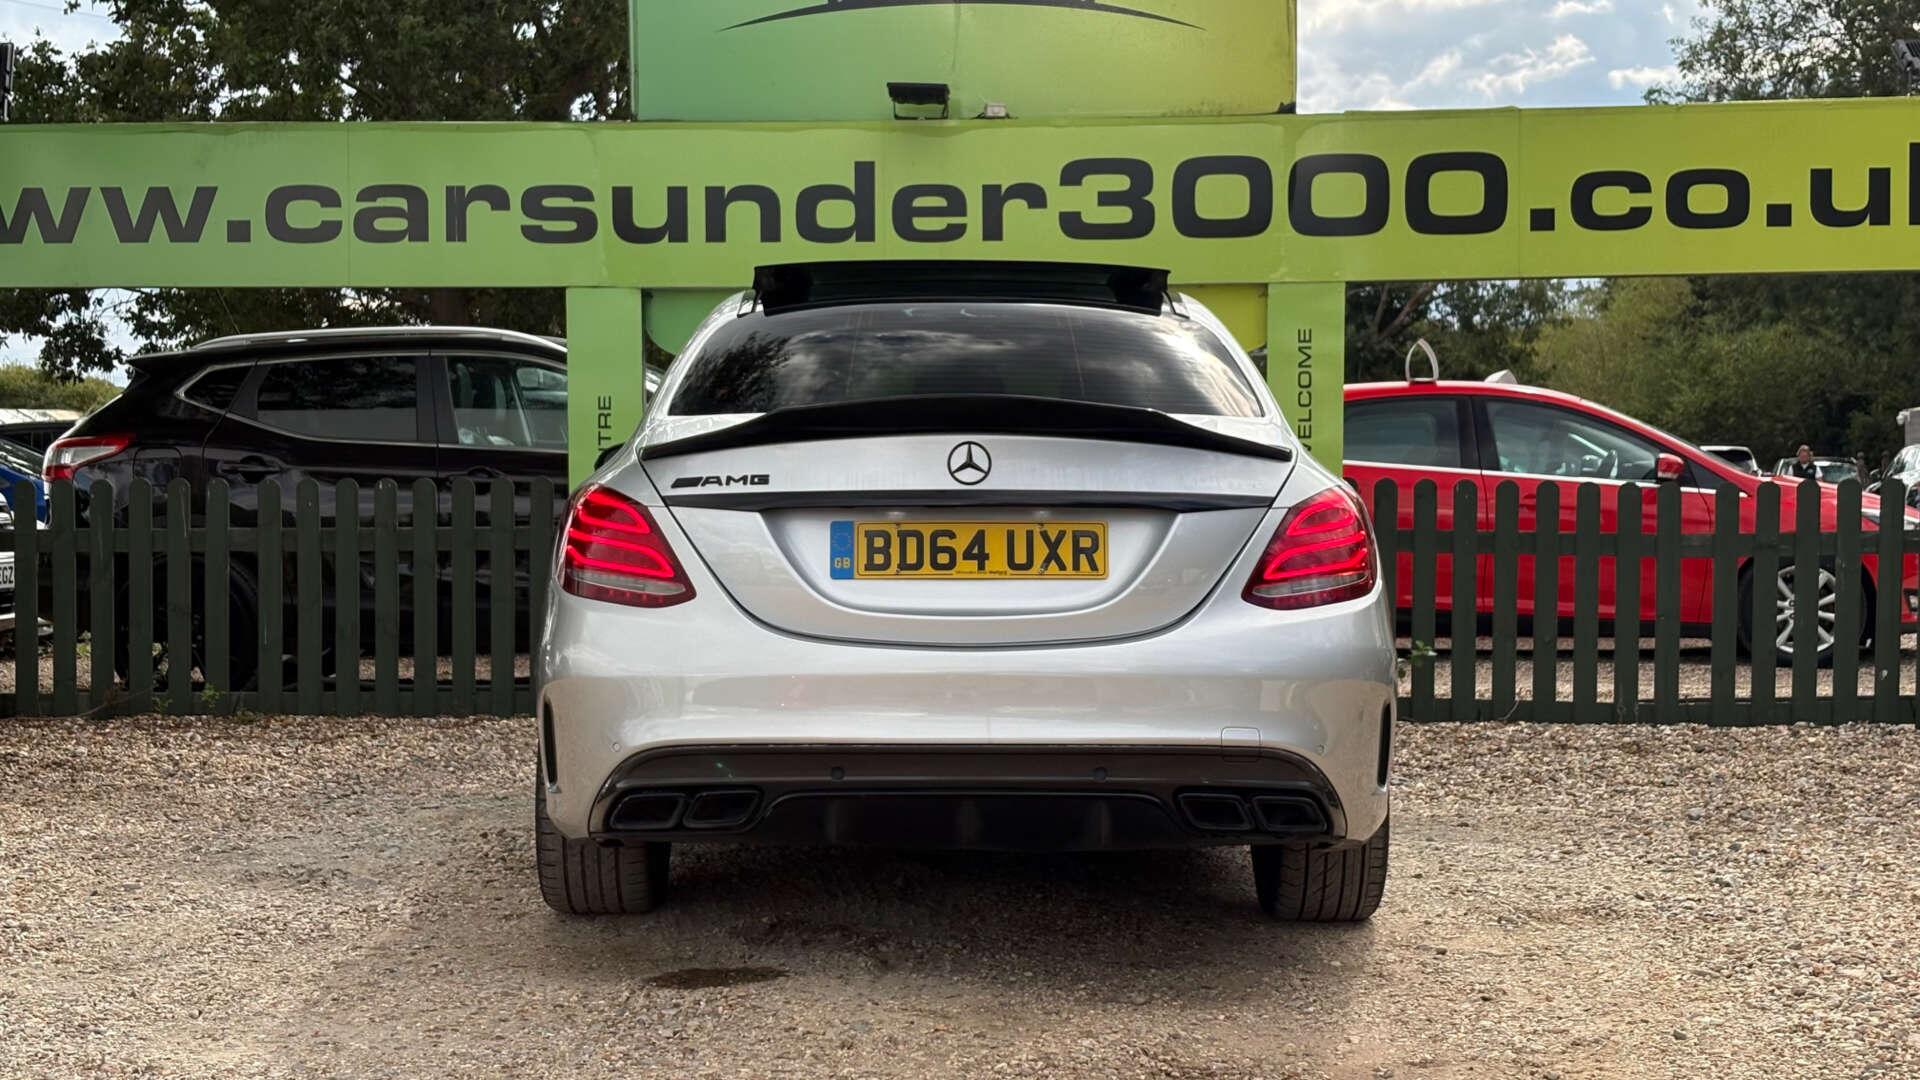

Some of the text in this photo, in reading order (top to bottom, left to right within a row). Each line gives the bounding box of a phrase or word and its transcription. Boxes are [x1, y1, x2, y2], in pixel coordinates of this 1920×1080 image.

[0, 142, 1920, 245] ww.carsunder3000.co.u
[1298, 328, 1312, 451] ELCOME
[597, 395, 612, 450] TRE
[701, 475, 770, 487] AMG
[834, 556, 851, 569] GB
[864, 530, 1101, 572] BD64 UXR
